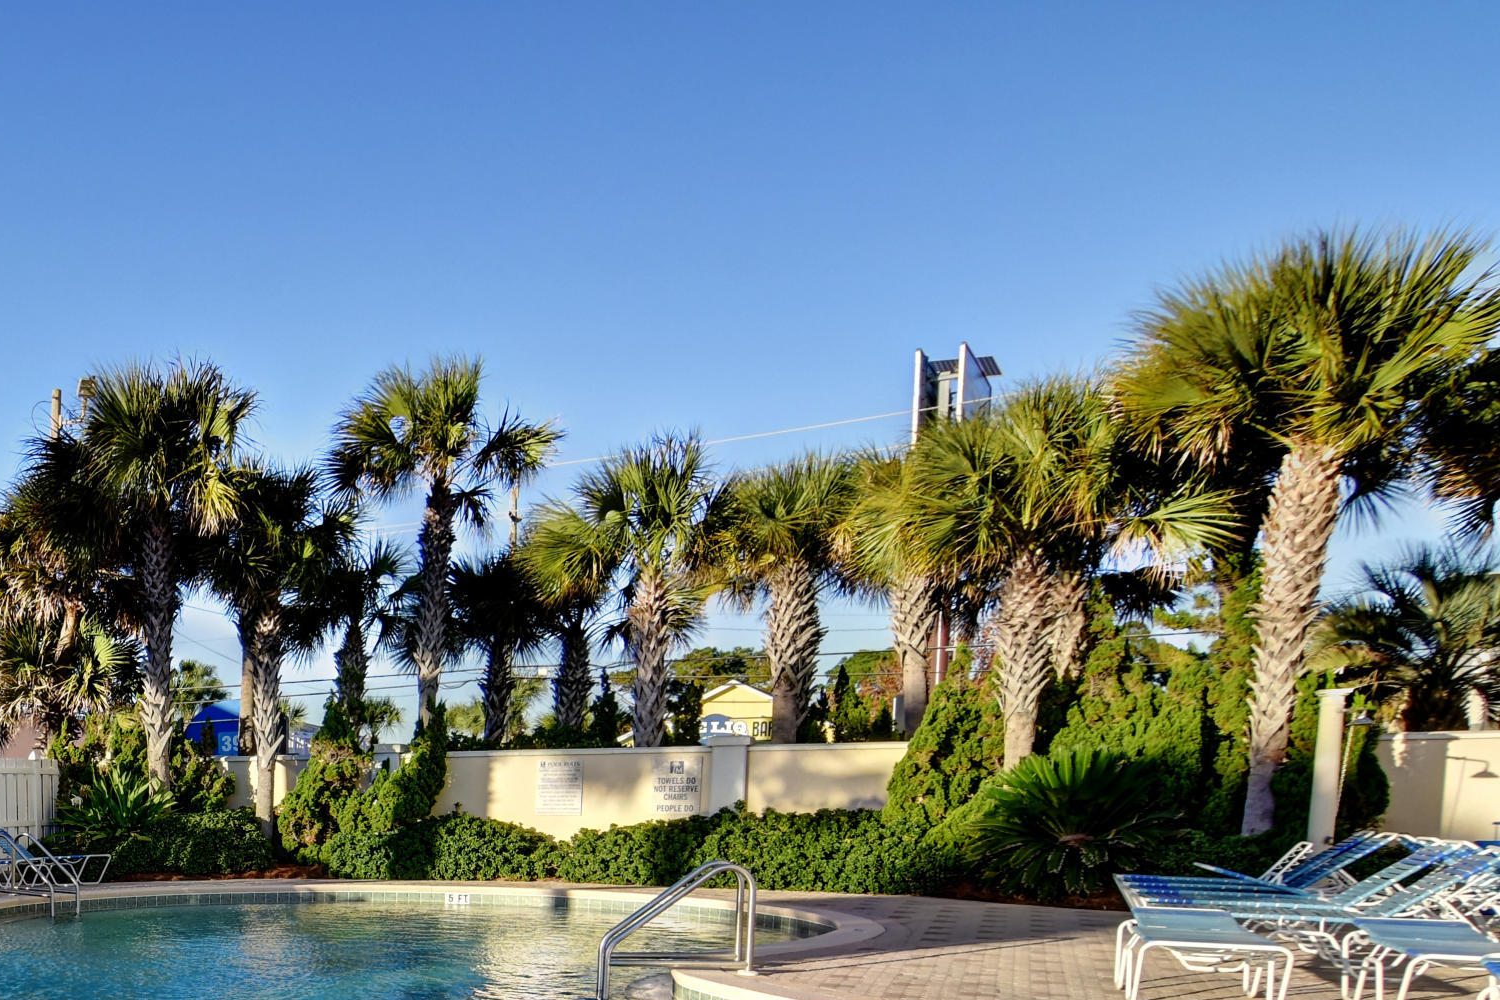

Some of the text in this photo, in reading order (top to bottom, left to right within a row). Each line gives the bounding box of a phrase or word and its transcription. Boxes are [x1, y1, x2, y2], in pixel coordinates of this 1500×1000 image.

[658, 777, 696, 785] TOWELS DO
[653, 785, 699, 793] NOT RESERVE
[663, 793, 688, 801] CHAIRS
[656, 804, 694, 813] PEOPLE DO
[448, 894, 469, 903] 5 FT
